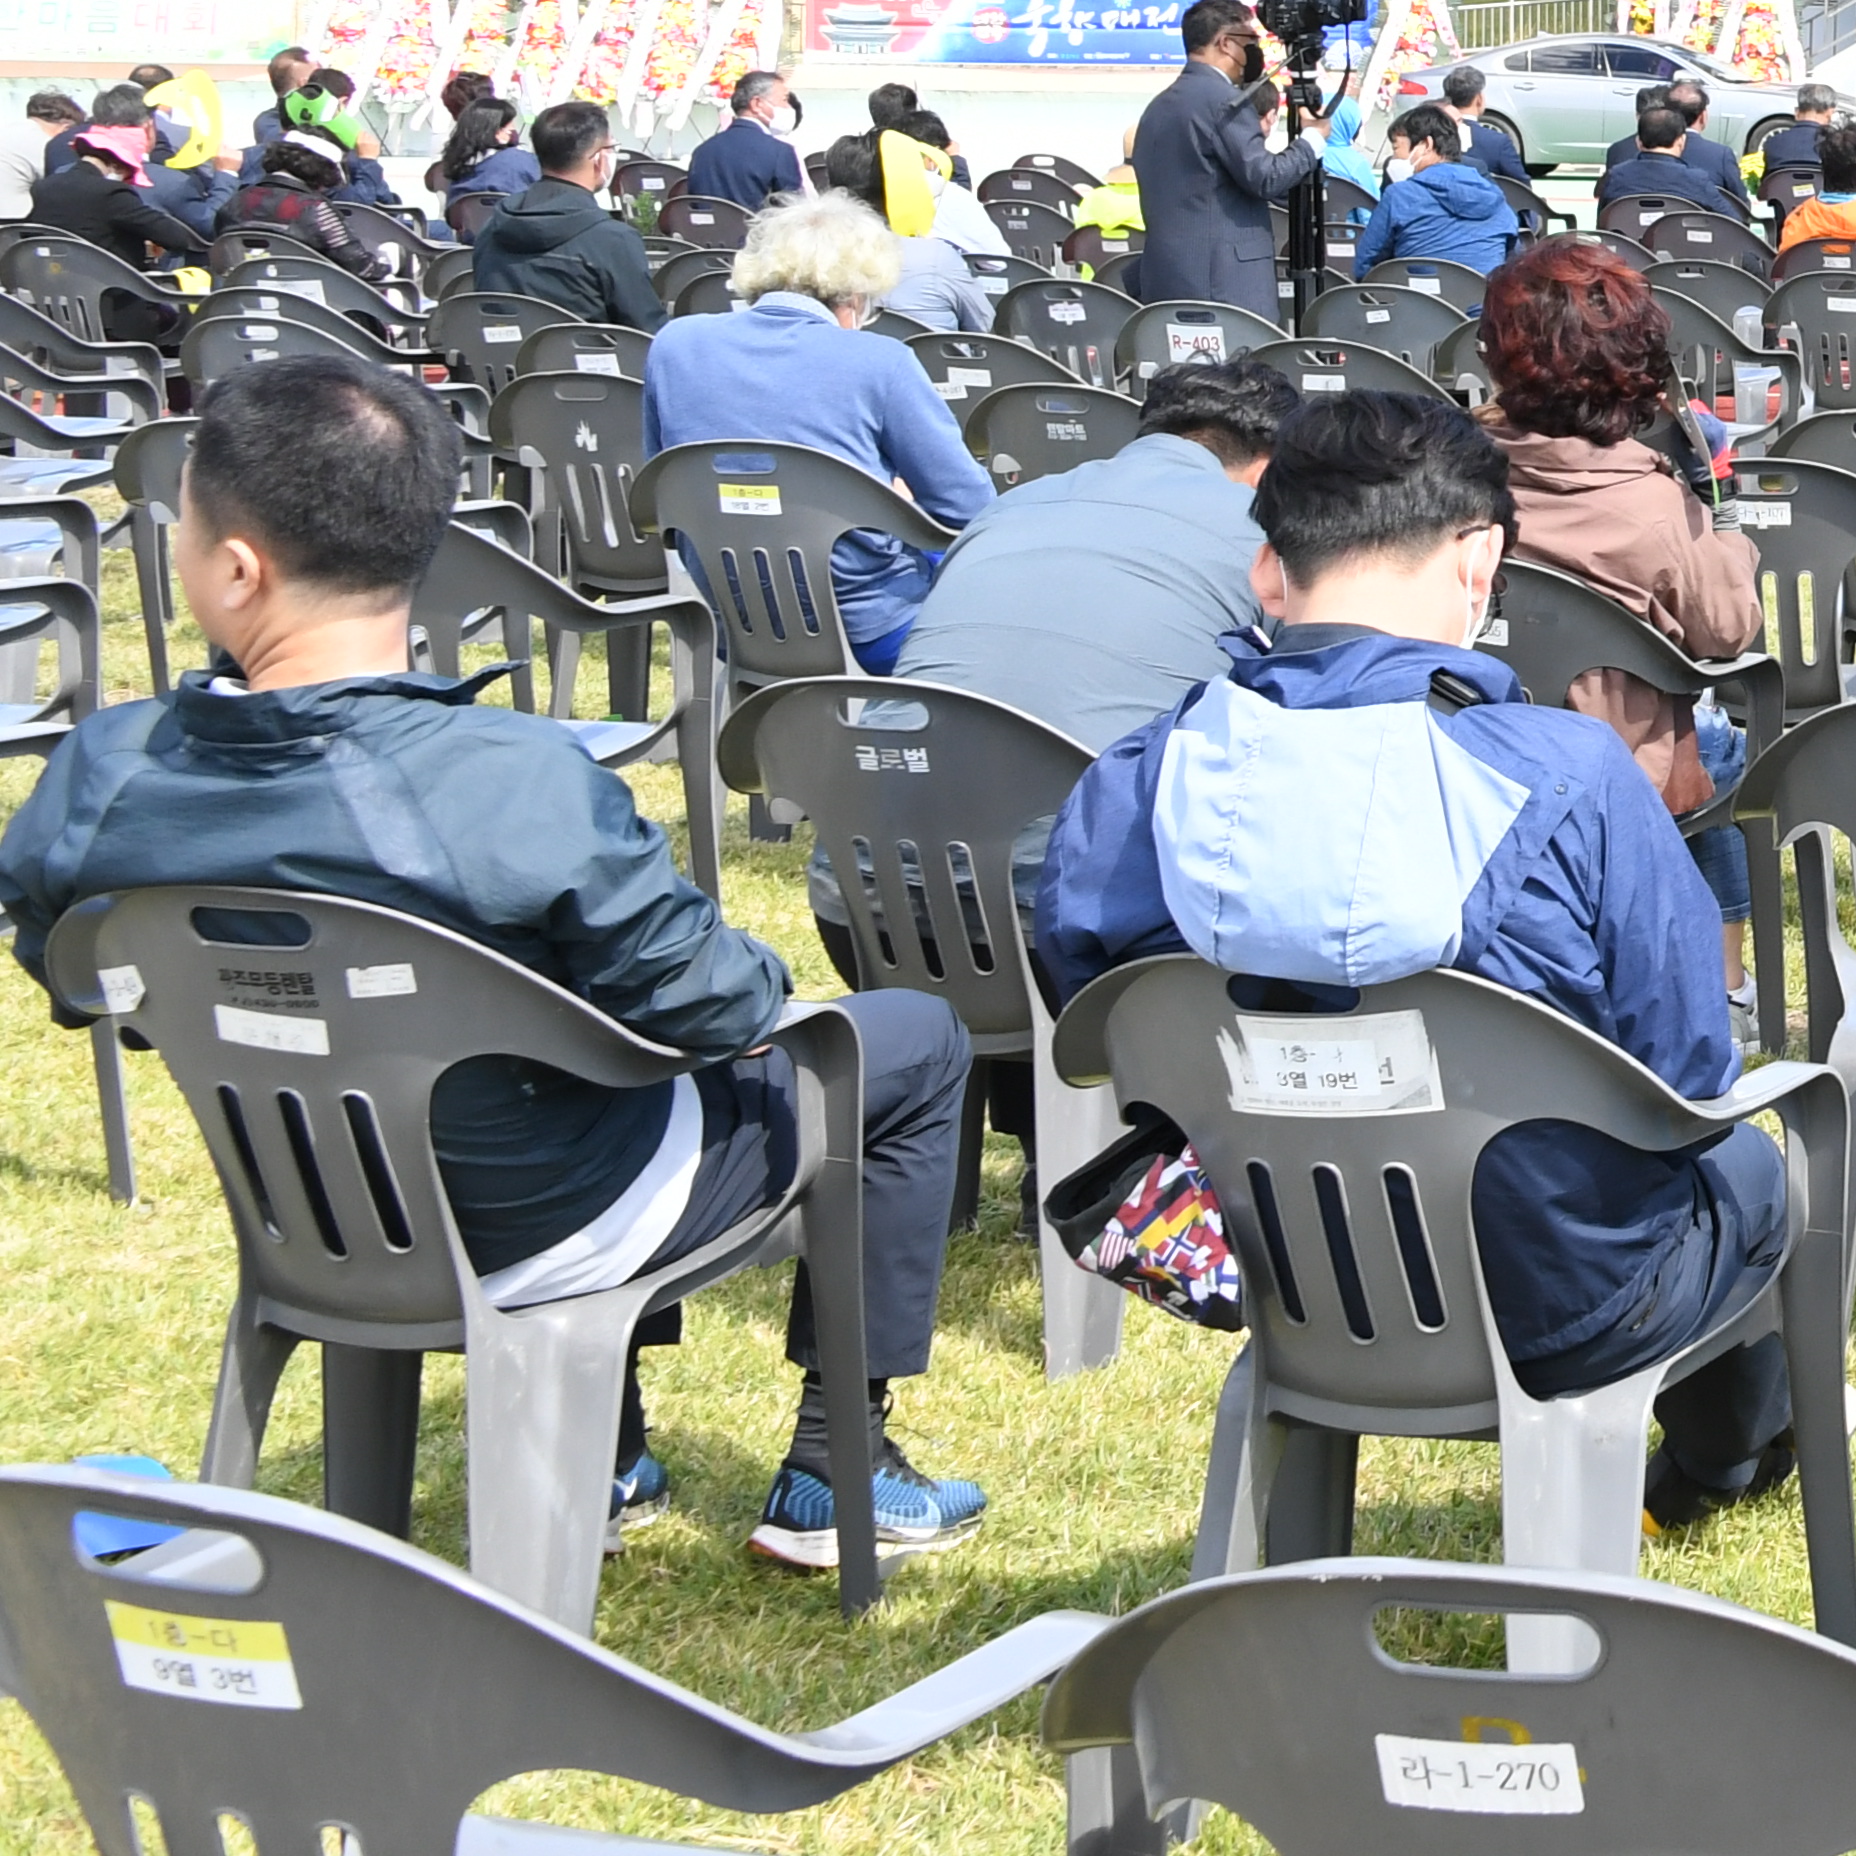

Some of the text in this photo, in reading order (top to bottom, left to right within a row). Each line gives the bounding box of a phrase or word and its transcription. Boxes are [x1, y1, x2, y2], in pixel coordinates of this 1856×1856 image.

[1172, 334, 1220, 352] R-403
[855, 745, 930, 773] 글로벌
[1318, 1071, 1358, 1089] 19번
[149, 1619, 238, 1652] 1층-다
[211, 1666, 258, 1694] 3번
[1400, 1755, 1560, 1792] 라-1-270
